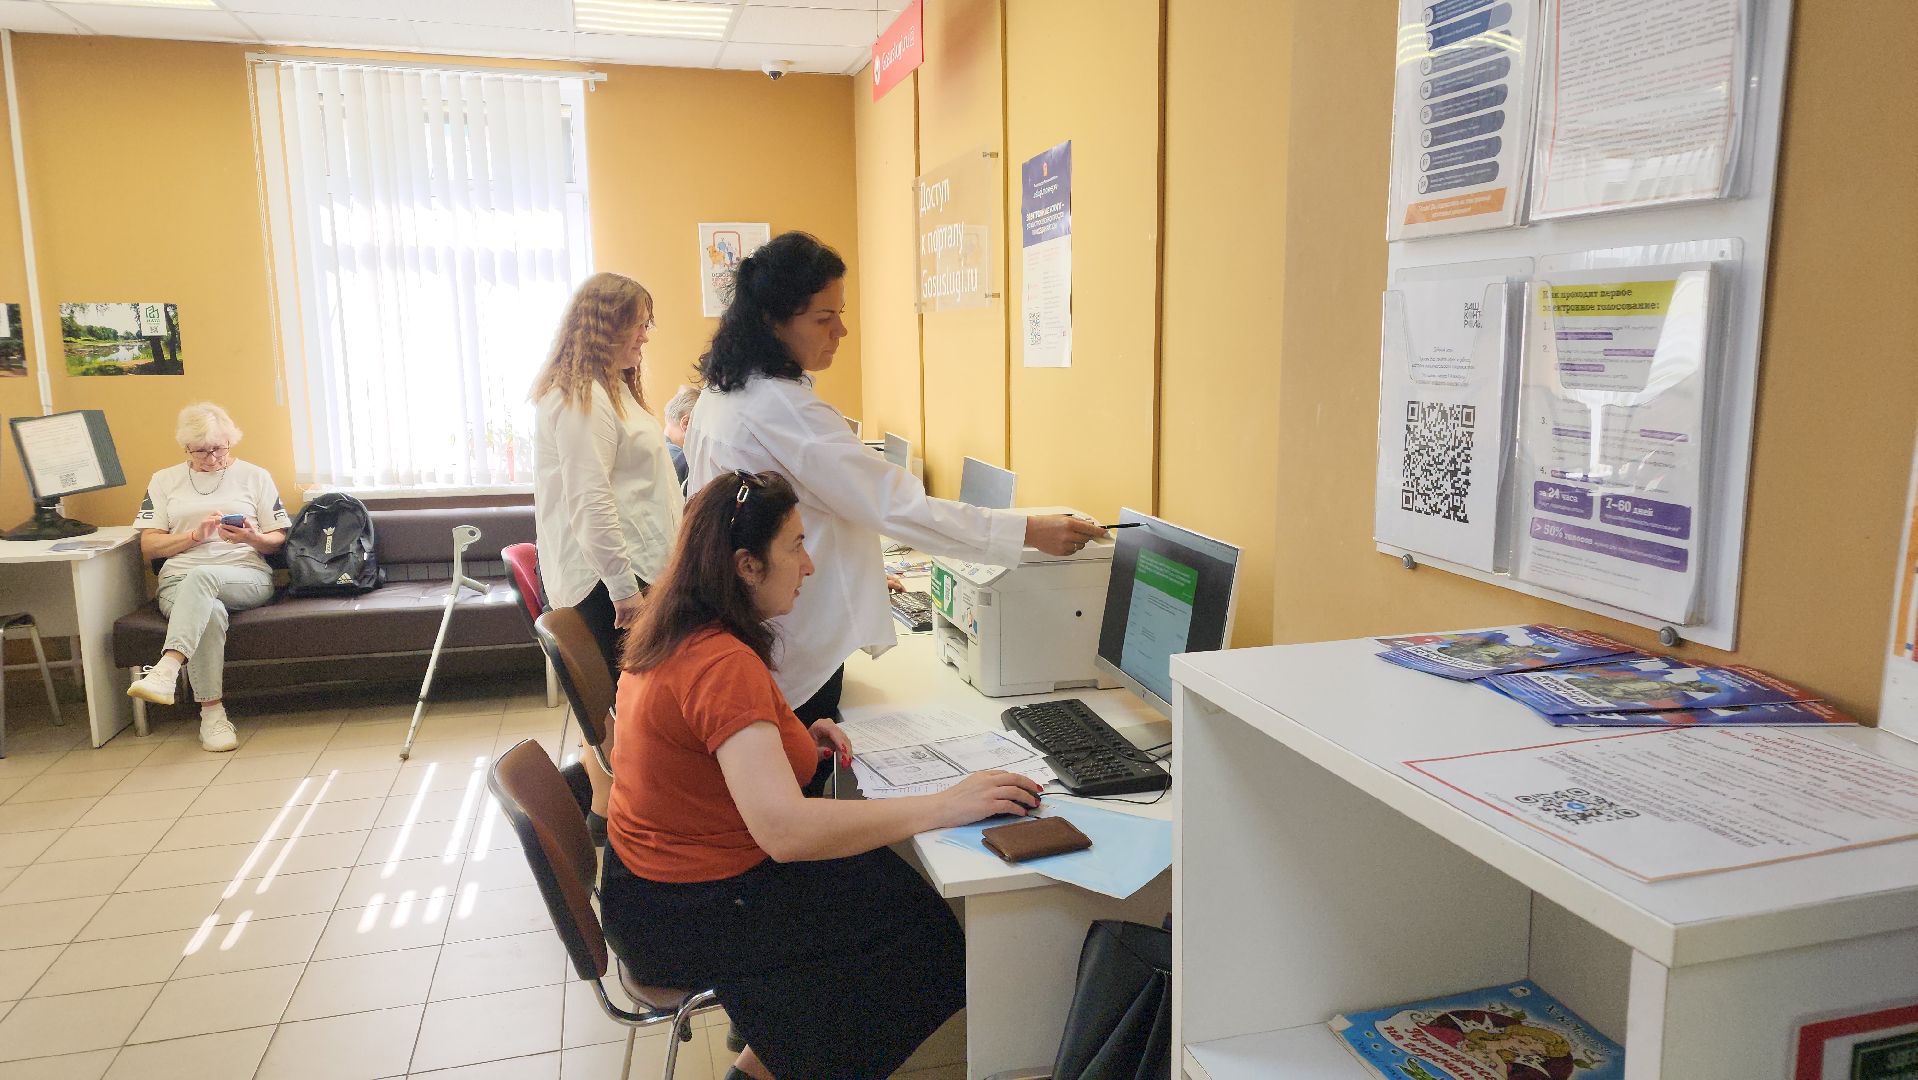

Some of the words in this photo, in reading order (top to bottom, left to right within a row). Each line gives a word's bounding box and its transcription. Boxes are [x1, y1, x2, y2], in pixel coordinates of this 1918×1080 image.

[919, 178, 950, 217] Доступ
[928, 221, 964, 259] порталу
[922, 260, 978, 302] Gosuslugi.ru
[1561, 291, 1598, 300] проходит
[1600, 288, 1632, 299] первое
[1597, 301, 1660, 312] голосование:
[1548, 487, 1560, 499] 24
[1543, 524, 1564, 538] 50%
[1384, 1026, 1404, 1041] на
